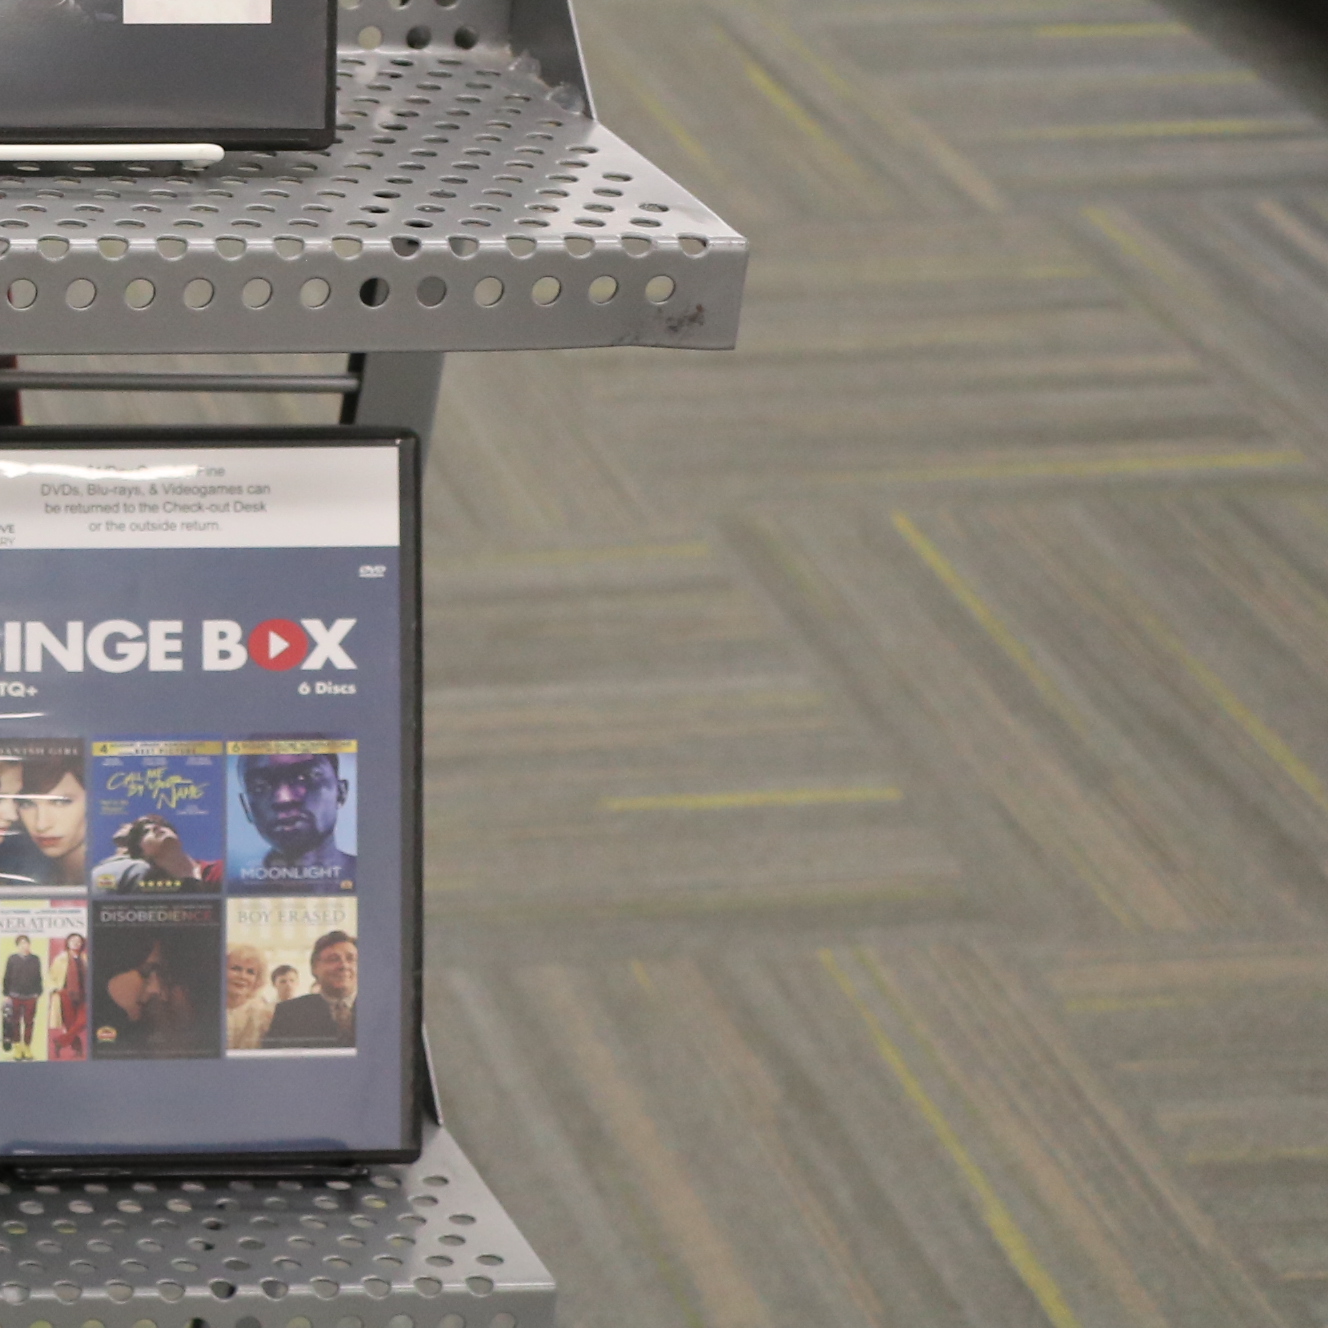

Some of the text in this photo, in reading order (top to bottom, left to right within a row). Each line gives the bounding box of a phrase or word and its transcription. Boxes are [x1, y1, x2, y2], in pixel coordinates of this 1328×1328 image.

[203, 618, 357, 670] BOX
[298, 681, 356, 695] 6 Discs
[241, 866, 342, 878] MOONLIGHT
[101, 910, 211, 922] DISOBEDIENCE
